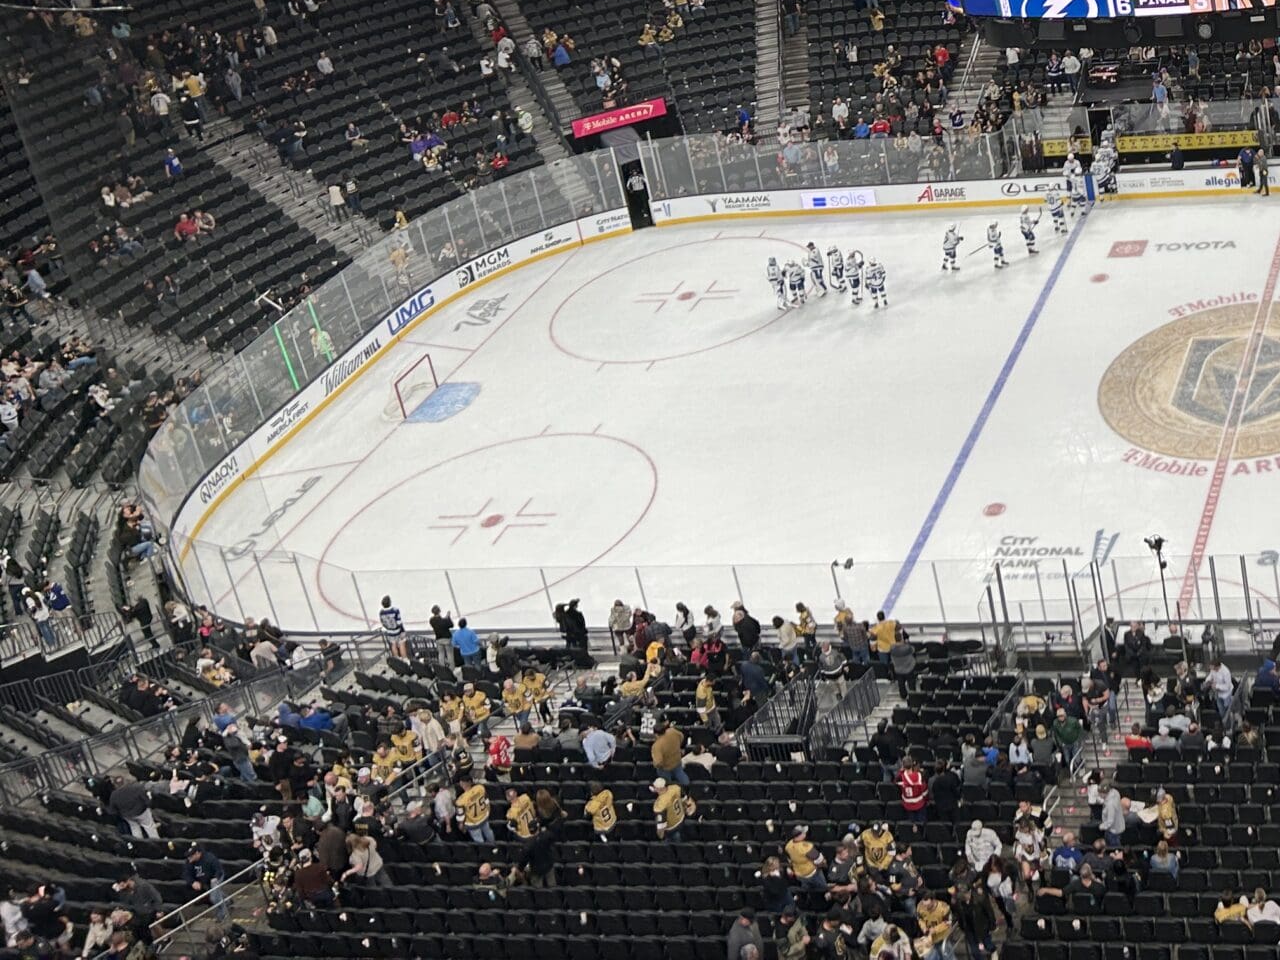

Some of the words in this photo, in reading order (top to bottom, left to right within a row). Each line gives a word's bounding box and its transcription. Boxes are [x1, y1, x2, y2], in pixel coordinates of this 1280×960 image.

[619, 109, 648, 121] ARENA
[1024, 183, 1066, 193] LEX
[1205, 176, 1241, 188] allegia
[934, 187, 966, 197] GARAGE
[611, 214, 629, 223] NATI
[1155, 239, 1237, 252] TOYOTA
[474, 247, 510, 272] MGM
[478, 259, 512, 279] REWARDS
[387, 288, 435, 336] UMC
[266, 417, 293, 444] AMERICA
[291, 401, 311, 421] FIRST
[208, 456, 239, 487] NAQVI
[1000, 535, 1038, 546] CITY
[994, 547, 1084, 557] NATIONAL
[1046, 572, 1094, 580] COMPAN
[468, 795, 487, 818] 75
[601, 805, 612, 822] 9
